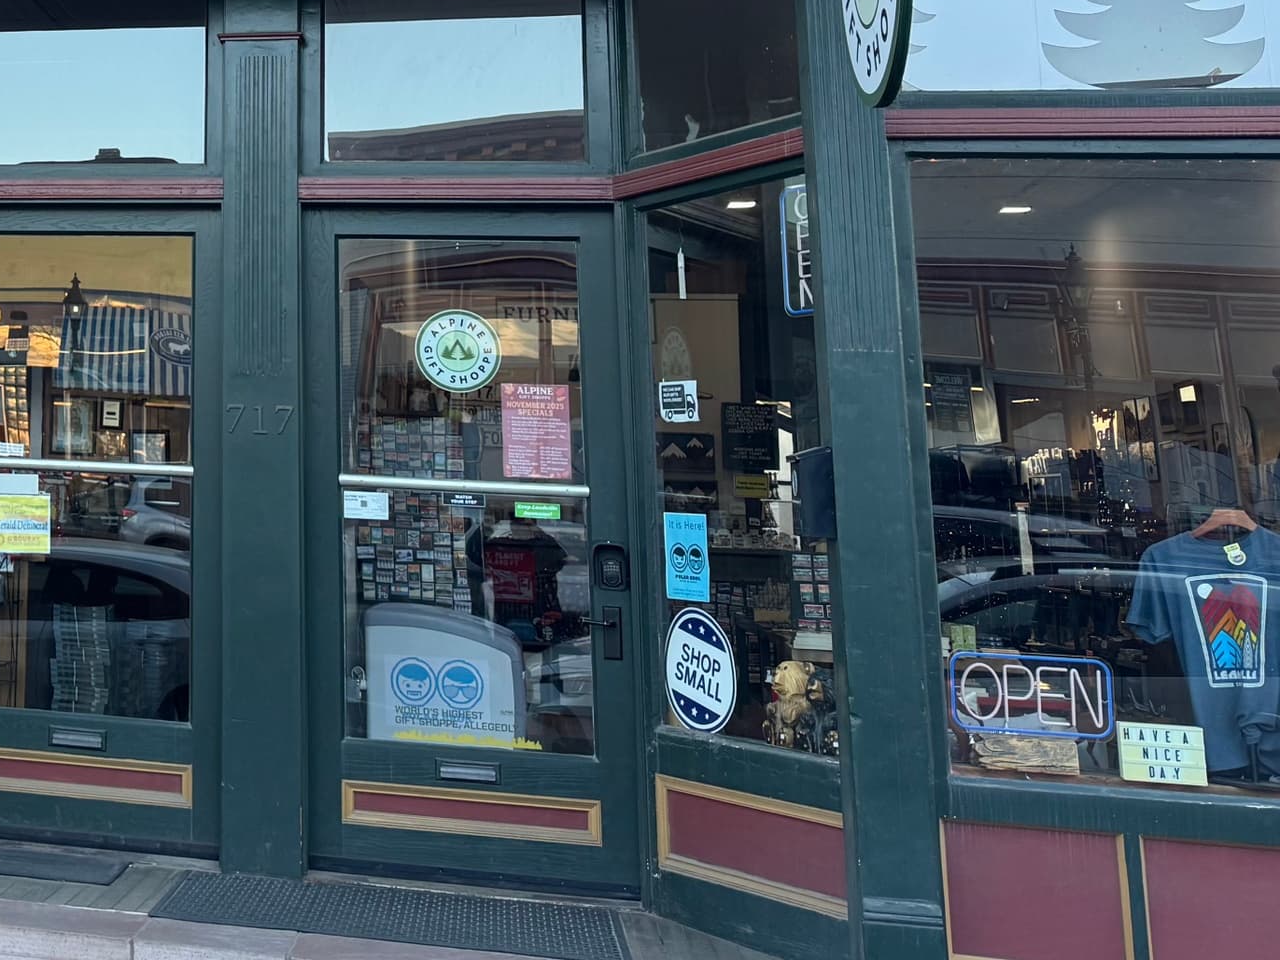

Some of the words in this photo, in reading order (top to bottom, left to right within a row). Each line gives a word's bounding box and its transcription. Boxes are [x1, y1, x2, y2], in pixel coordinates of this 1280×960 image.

[430, 318, 486, 339] ALPINE
[424, 346, 445, 377] GIFT
[449, 347, 493, 385] SHOPPE
[517, 386, 554, 396] ALPINE
[506, 401, 546, 410] NOVEMBER
[546, 402, 565, 411] 2025
[518, 408, 554, 417] SPECIALS
[225, 404, 295, 436] 717
[668, 519, 674, 529] It
[675, 520, 682, 529] is
[684, 520, 705, 531] Here!
[680, 643, 721, 677] SHOP
[674, 661, 723, 704] SMALL
[960, 661, 1104, 729] OPEN
[394, 705, 439, 718] WORLD'S
[441, 708, 484, 721] HIGHEST
[394, 716, 416, 726] GIFT
[1123, 727, 1171, 744] HAVE
[1183, 731, 1189, 744] A
[1142, 748, 1182, 762] NICE
[1148, 766, 1181, 780] DAY
